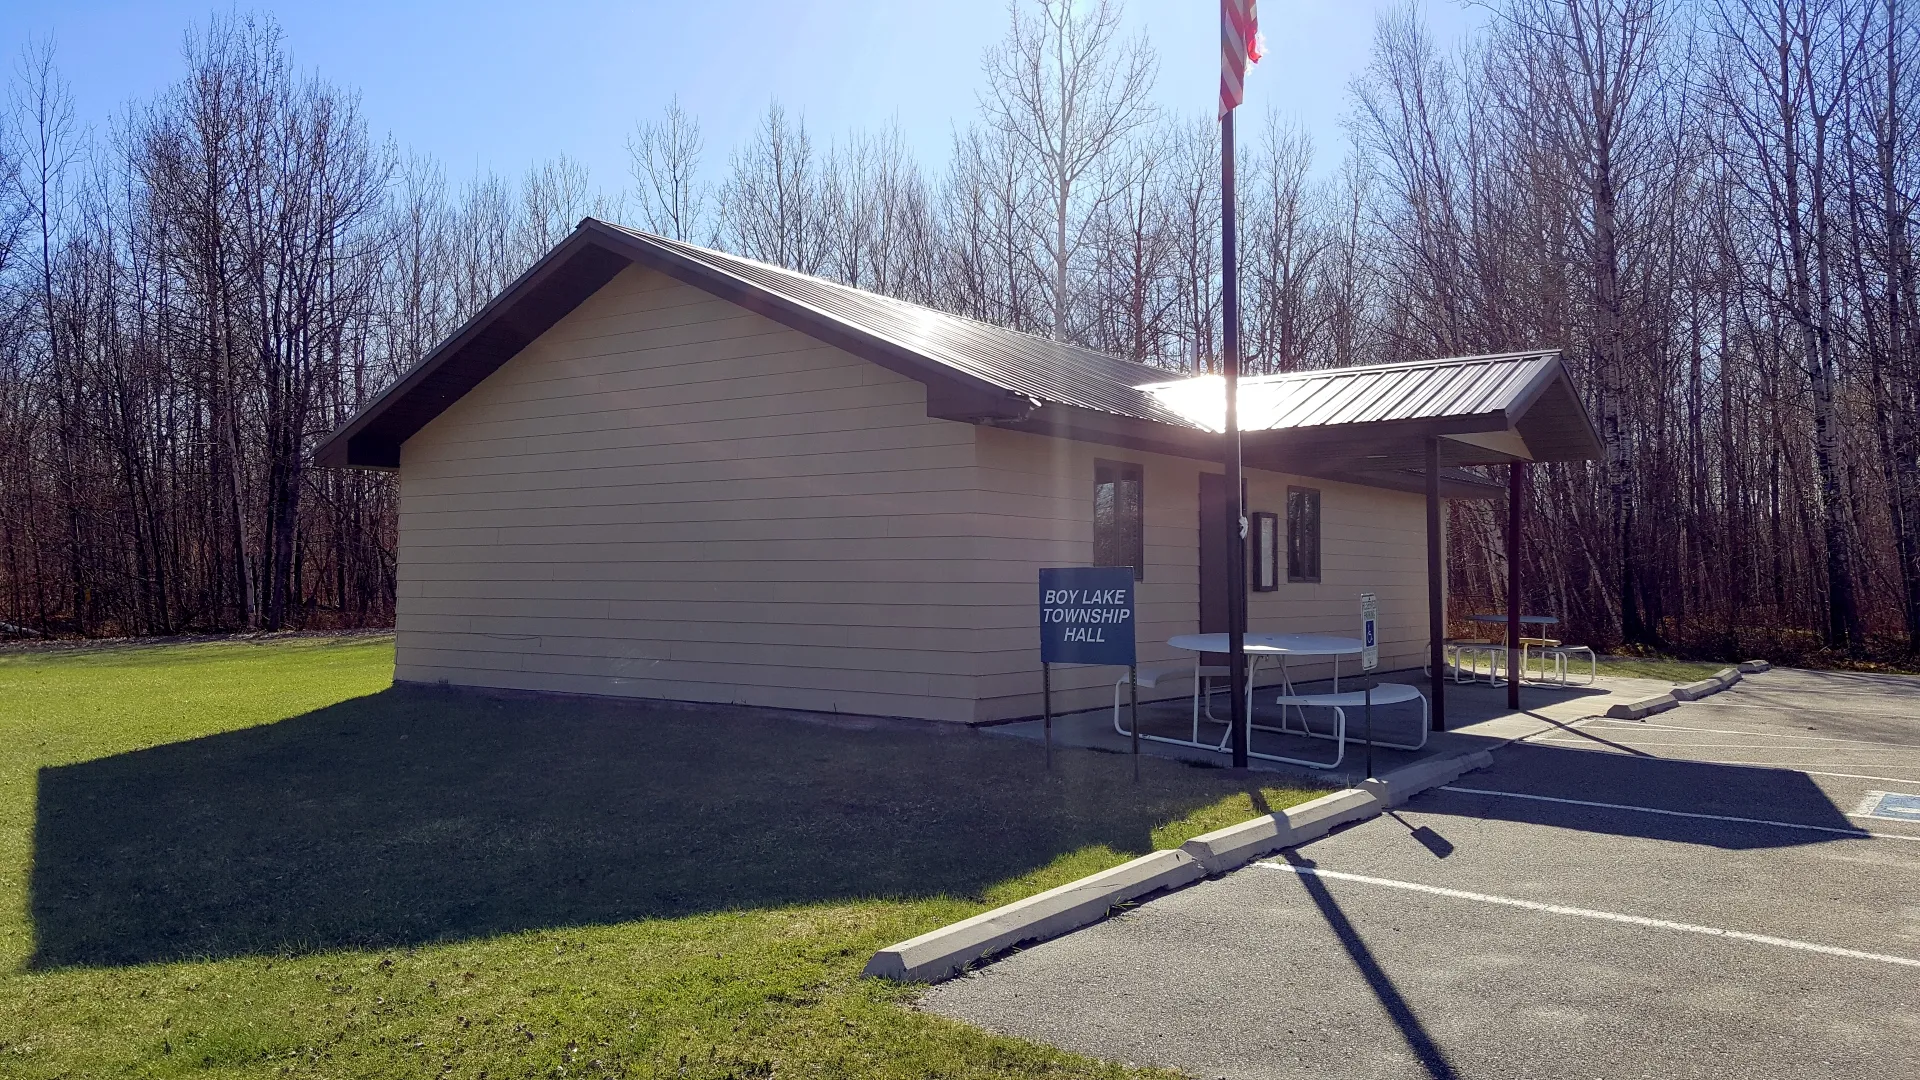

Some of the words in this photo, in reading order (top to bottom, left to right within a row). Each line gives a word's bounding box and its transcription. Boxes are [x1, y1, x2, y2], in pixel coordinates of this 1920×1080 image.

[1044, 589, 1079, 605] BOY
[1082, 589, 1126, 605] LAKE
[1043, 608, 1131, 624] TOWNSHIP
[1063, 627, 1105, 643] HALL
